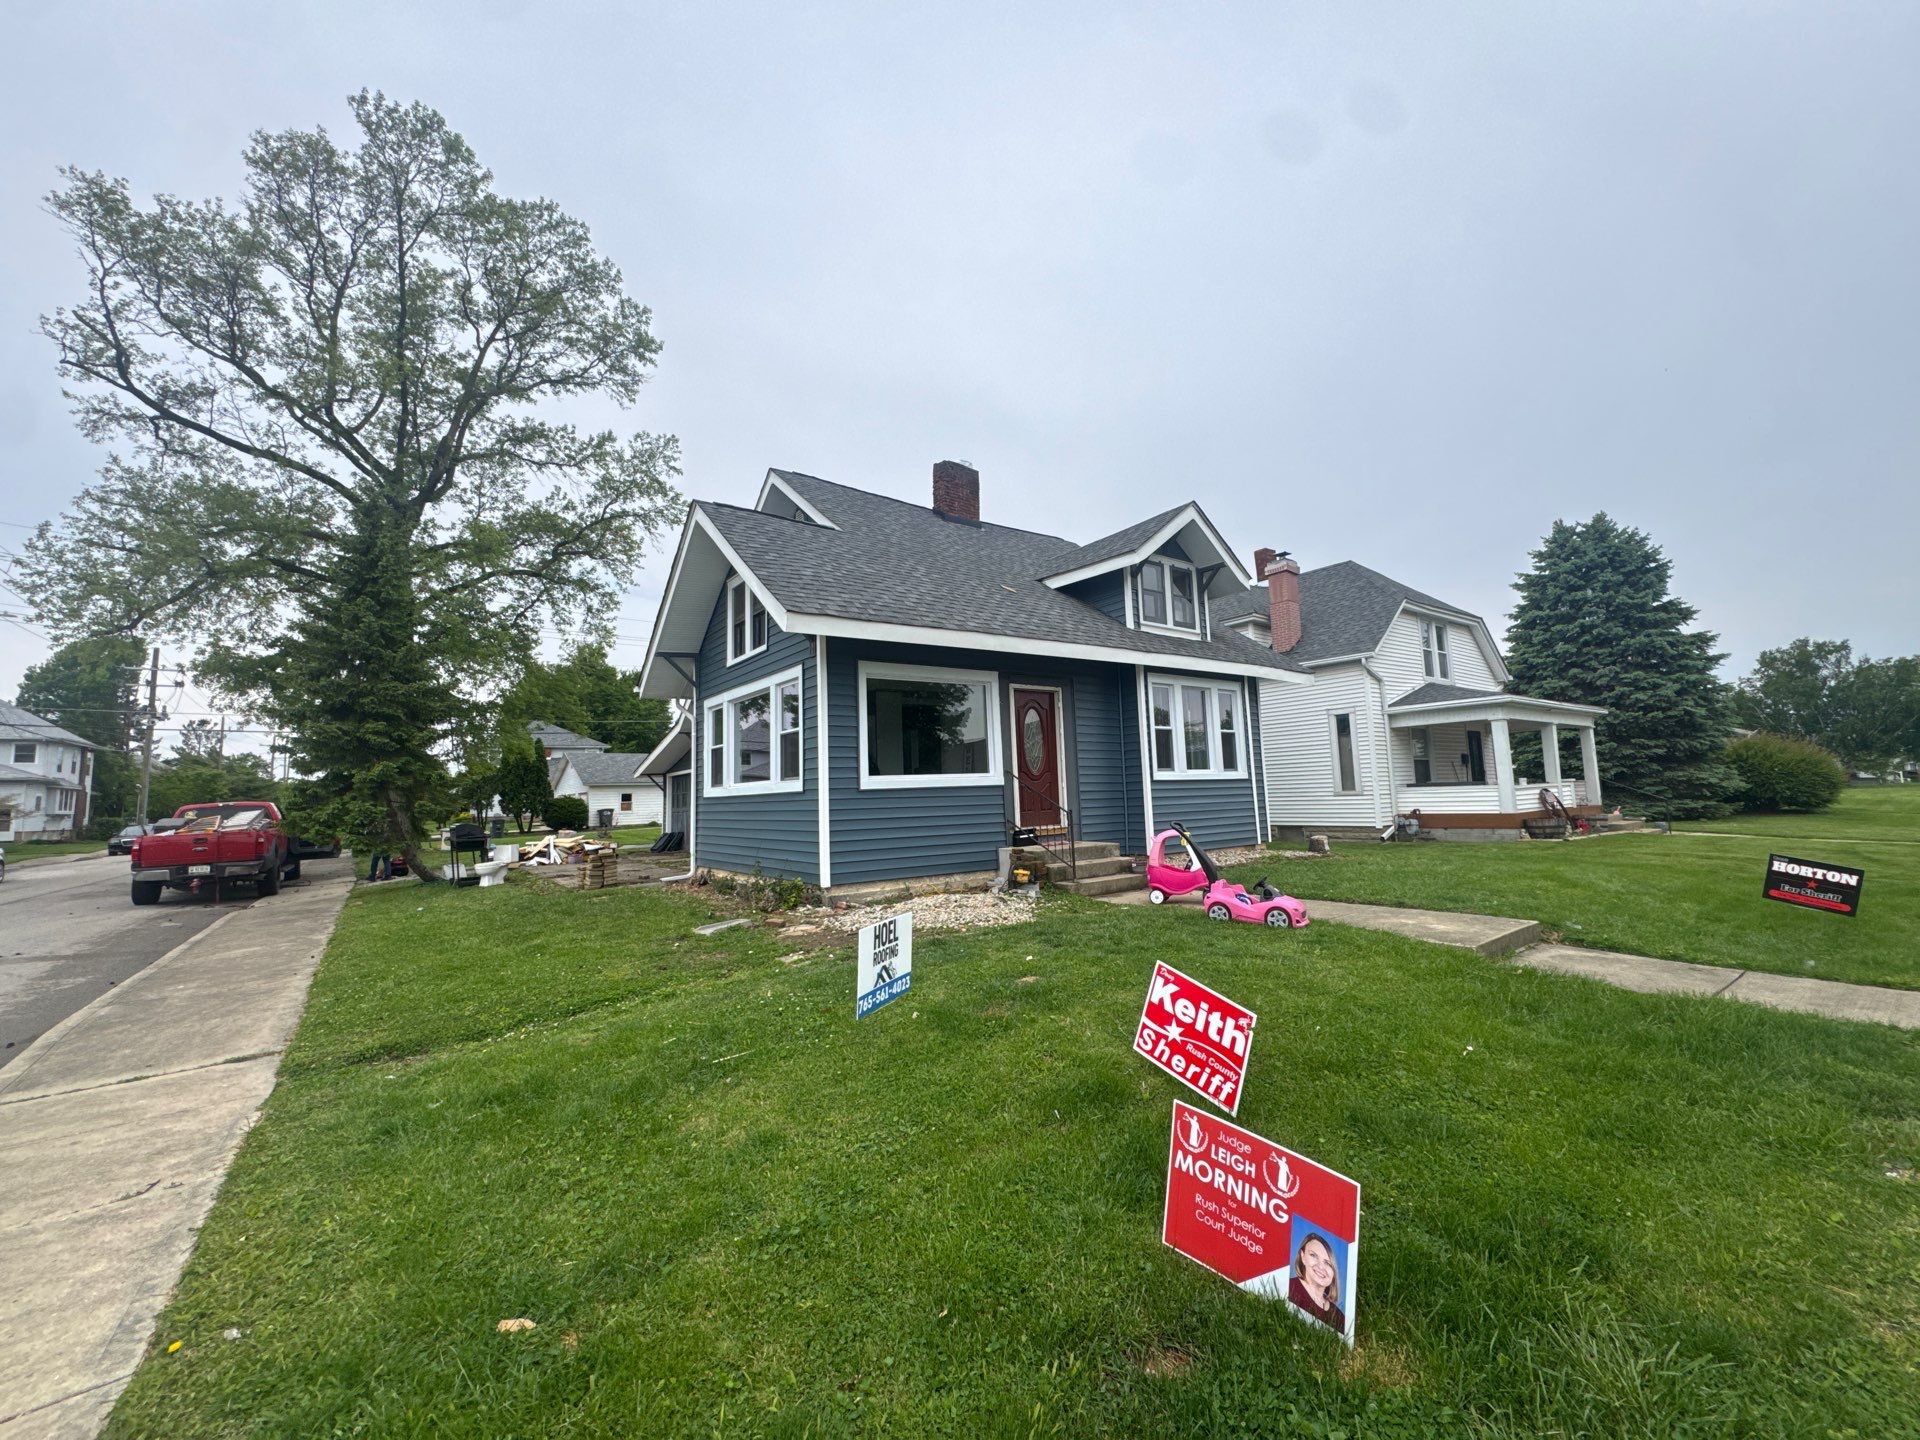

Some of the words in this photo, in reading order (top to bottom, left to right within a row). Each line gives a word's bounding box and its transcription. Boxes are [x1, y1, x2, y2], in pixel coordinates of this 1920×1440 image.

[1772, 860, 1859, 886] HORTON
[1800, 888, 1842, 902] Sheriff
[873, 919, 899, 950] HOEL
[873, 943, 899, 966] ROOFING
[858, 975, 910, 1014] 765-561-4023
[1150, 975, 1246, 1058] Keith
[1138, 1028, 1236, 1101] Sheriff
[1186, 1043, 1207, 1061] Rush
[1208, 1057, 1238, 1082] County
[1210, 1143, 1256, 1178] LEIGH
[1217, 1131, 1252, 1154] Judge
[1174, 1149, 1289, 1224] MORNING
[1228, 1199, 1237, 1209] for
[1195, 1193, 1219, 1215] Rush
[1221, 1207, 1266, 1240] Superior
[1195, 1209, 1226, 1233] Court
[1228, 1229, 1264, 1255] Judge
